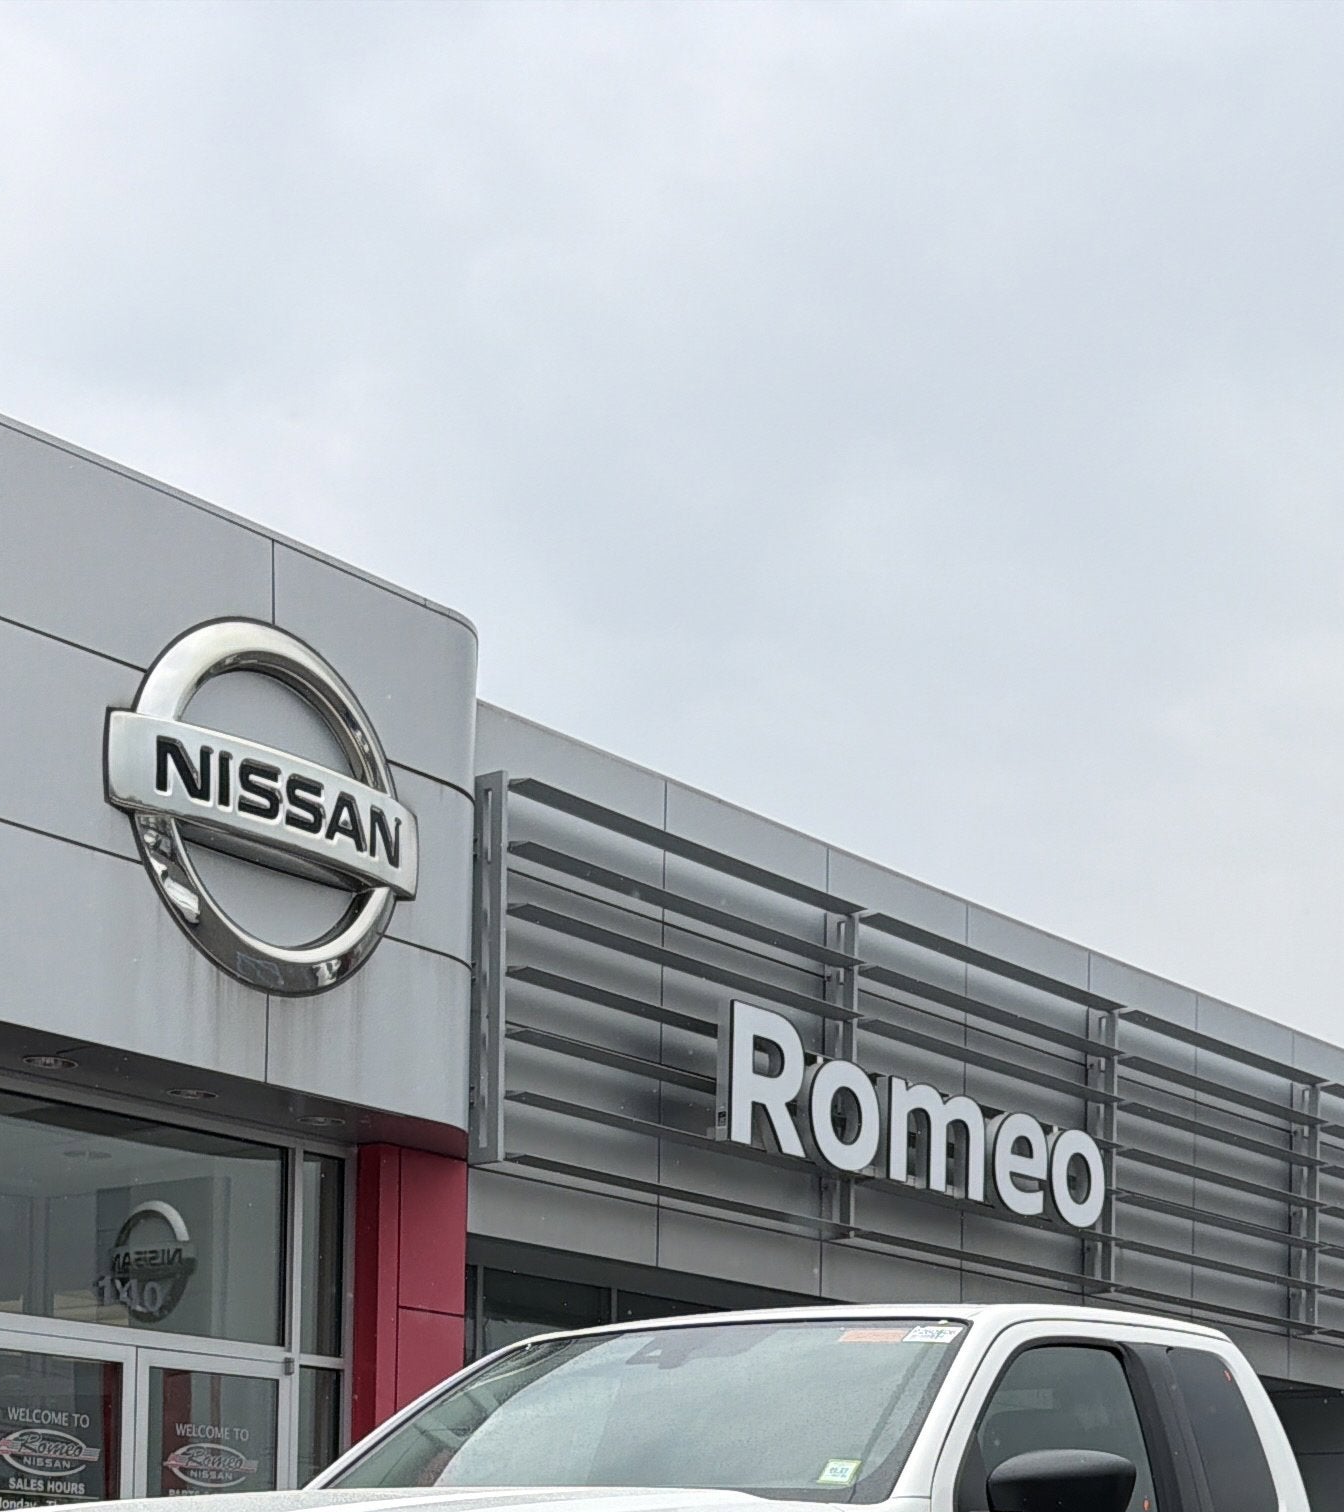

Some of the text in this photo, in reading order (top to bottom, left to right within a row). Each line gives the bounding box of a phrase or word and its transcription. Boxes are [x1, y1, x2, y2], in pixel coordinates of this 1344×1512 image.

[155, 734, 402, 868] NISSAN
[729, 999, 1107, 1229] Romeo
[8, 1407, 90, 1428] WELCOME TO
[176, 1423, 249, 1441] WELCOME TO
[17, 1431, 84, 1458] Romeo
[23, 1456, 71, 1469] NISSAN
[182, 1446, 245, 1470] Romeo
[190, 1469, 233, 1480] NISSAN
[9, 1477, 85, 1495] SALES HOURS
